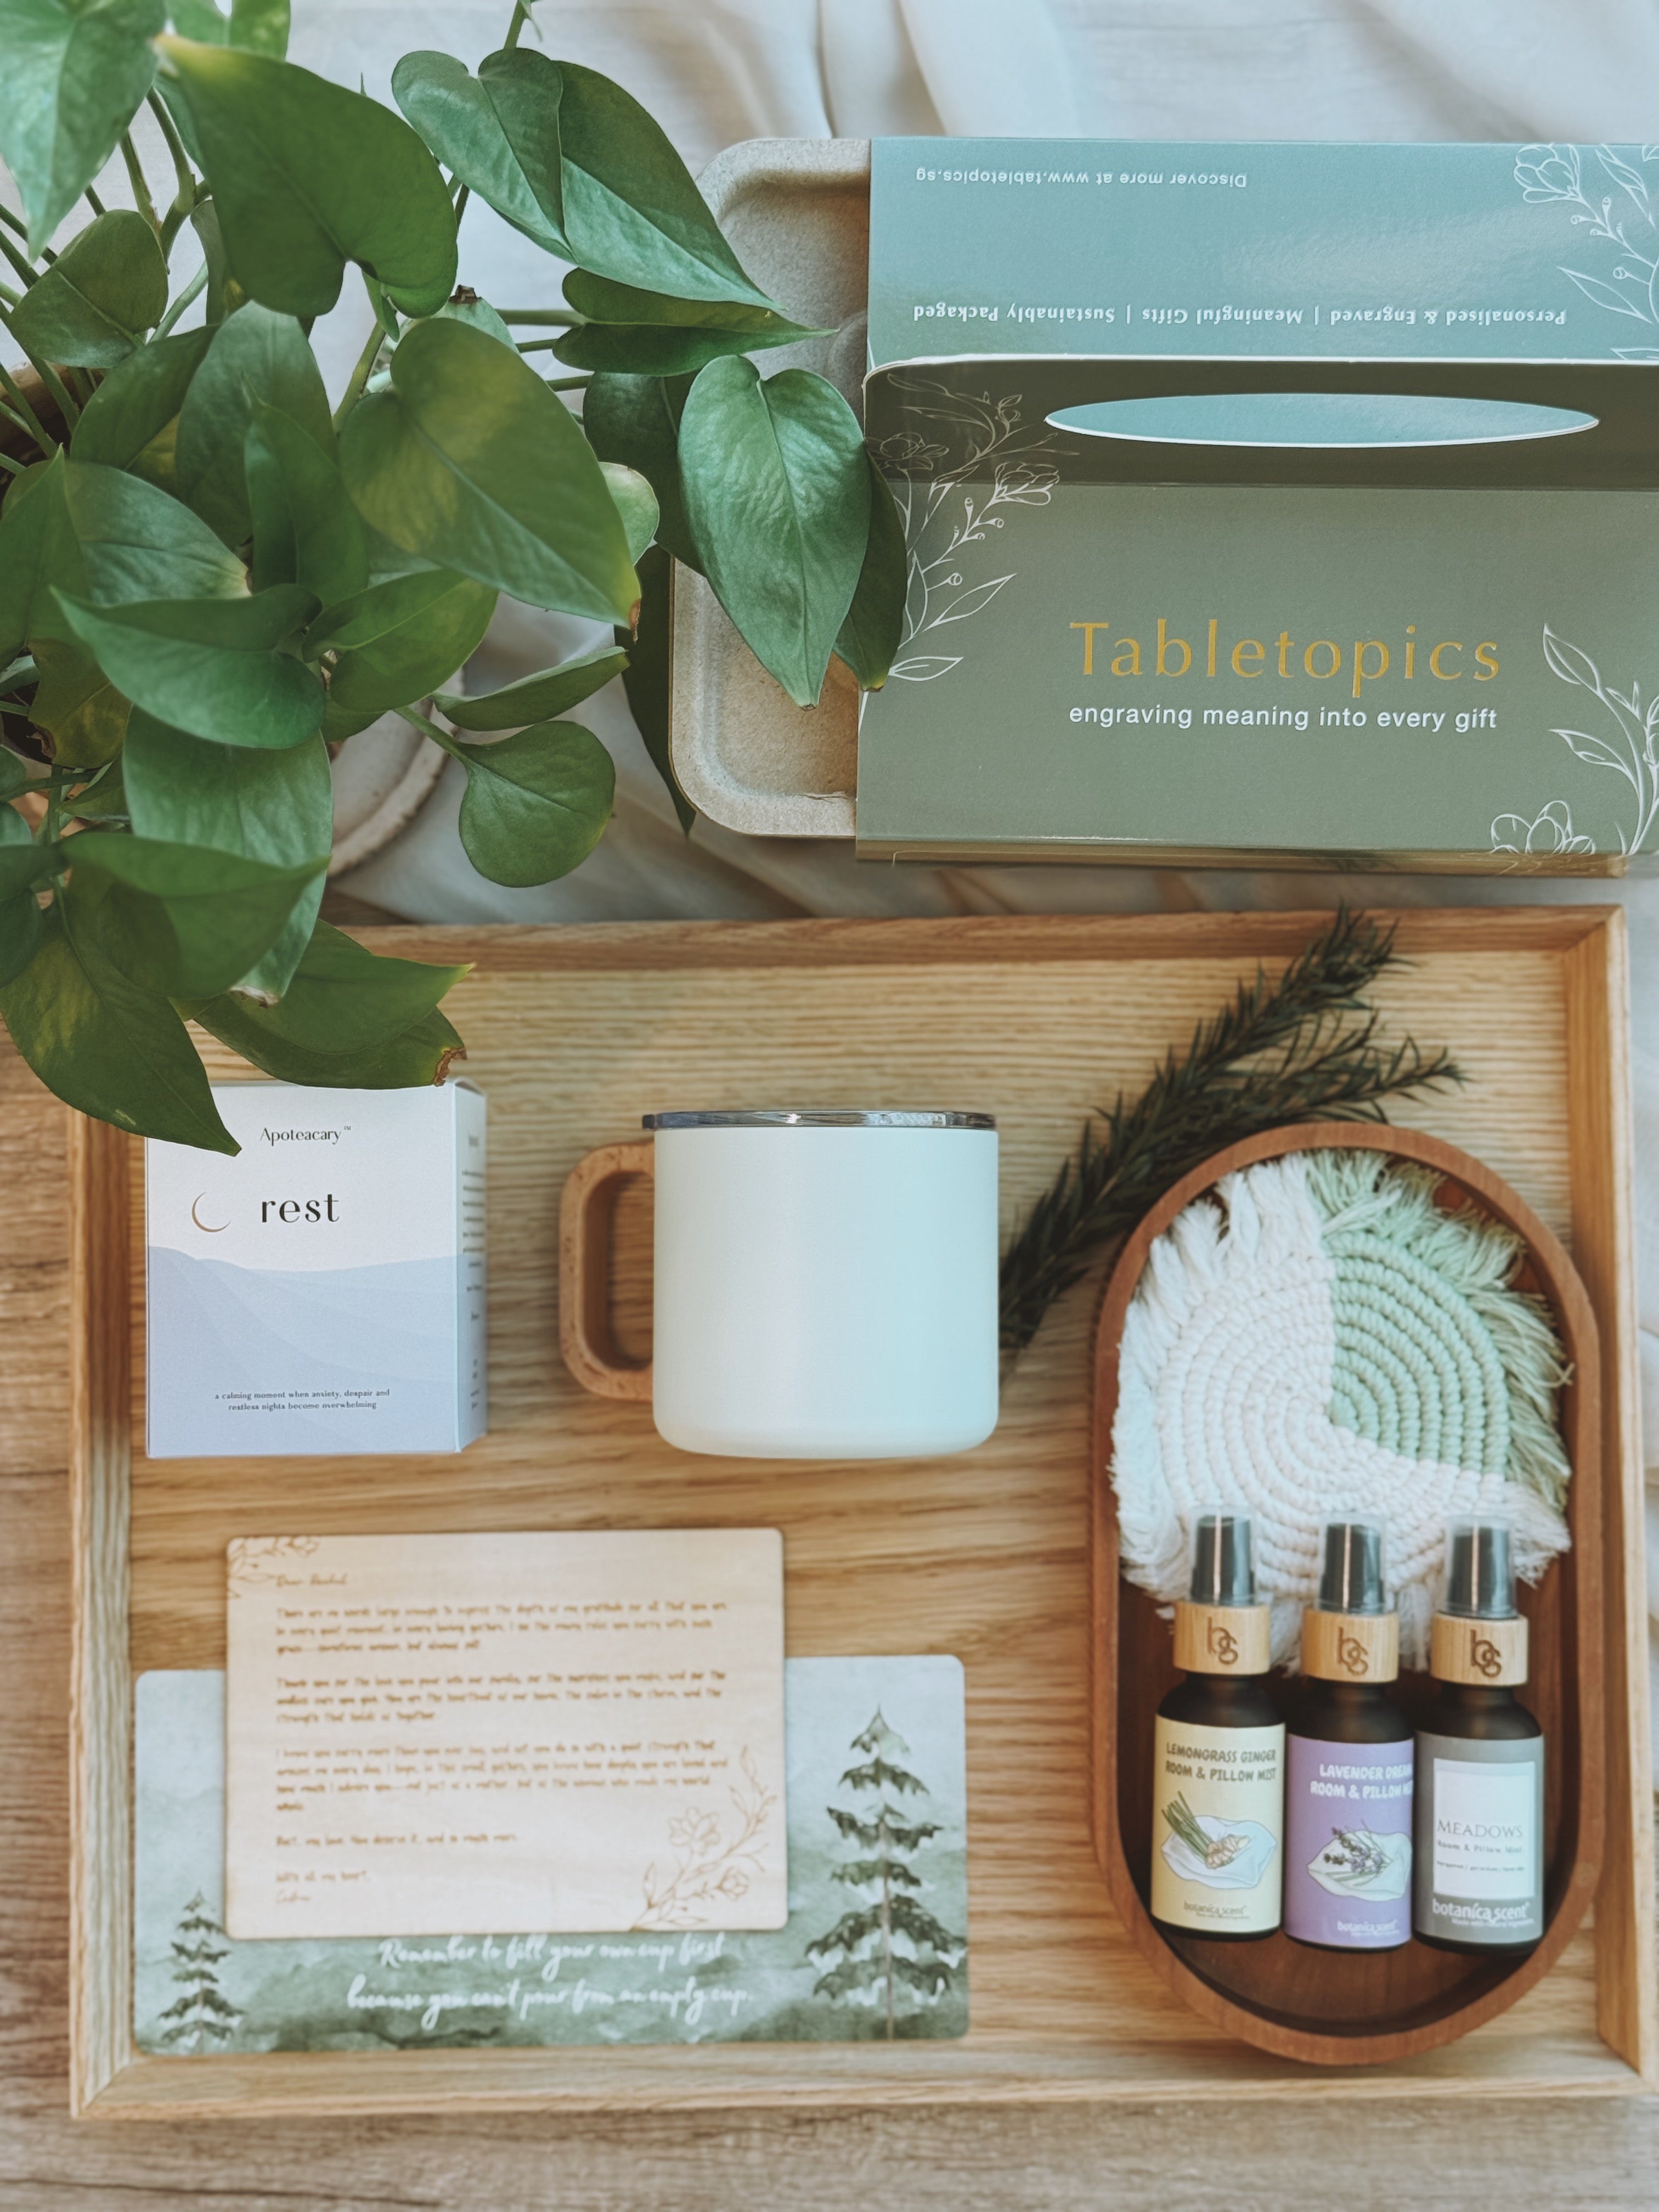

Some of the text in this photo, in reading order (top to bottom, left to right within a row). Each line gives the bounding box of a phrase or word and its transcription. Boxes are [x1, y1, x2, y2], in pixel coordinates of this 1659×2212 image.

[916, 166, 1247, 188] Discover more at www.tabletopics.sg
[913, 302, 999, 321] Packaged
[1007, 302, 1115, 324] Sustainably
[1142, 306, 1188, 325] Gifts
[1196, 304, 1304, 325] Meaningful
[1330, 306, 1417, 326] Engraved
[1424, 309, 1440, 325] &
[1446, 308, 1567, 325] Personalised
[1069, 618, 1500, 699] Tabletopics
[1069, 704, 1497, 733] engraving meaning into every gift
[262, 1194, 340, 1223] rest
[222, 1392, 251, 1401] calming
[262, 1402, 286, 1412] nights
[1166, 1741, 1276, 1763] LEMONGRASS GINGER
[1165, 1760, 1193, 1778] ROOM
[1195, 1766, 1206, 1780] &
[1210, 1768, 1254, 1782] PILLOW
[1319, 1763, 1384, 1780] LAVENDER
[1310, 1780, 1346, 1798] ROOM
[1348, 1784, 1360, 1800] &
[1362, 1785, 1402, 1799] PILLOW
[1437, 1818, 1523, 1838] MEADOWS
[378, 1934, 477, 1969] Remember
[482, 1935, 501, 1962] to
[505, 1934, 548, 1970] fill
[541, 1943, 595, 1983] your
[637, 1943, 675, 1973] cup
[679, 1931, 725, 1966] first
[347, 1973, 422, 2010] because
[420, 1993, 467, 2031] you
[519, 1989, 571, 2021] pour
[572, 1978, 614, 2015] from
[648, 1976, 704, 2025] empty
